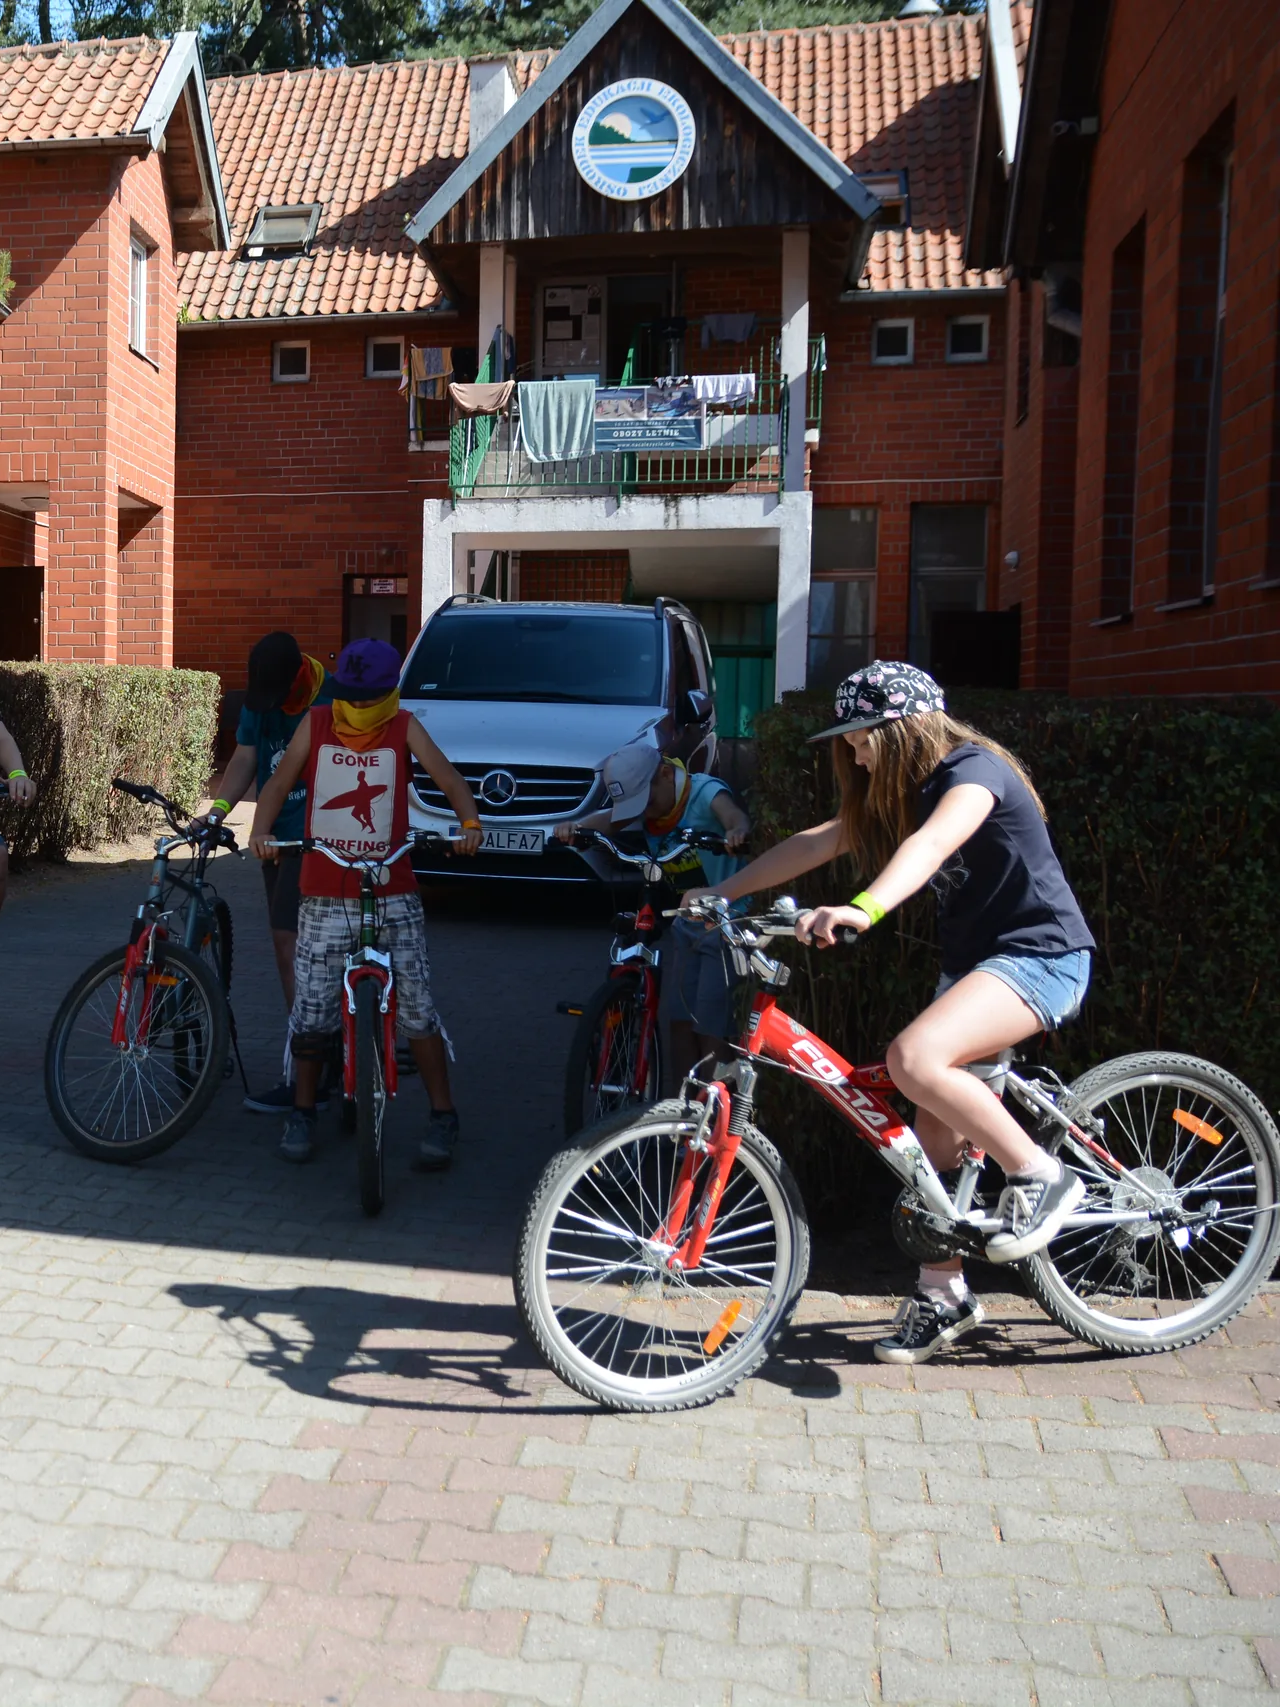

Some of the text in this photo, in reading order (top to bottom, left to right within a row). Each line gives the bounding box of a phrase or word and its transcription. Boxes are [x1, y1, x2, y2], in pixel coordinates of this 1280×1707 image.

[645, 429, 680, 437] LETNIE
[332, 752, 380, 768] GONE
[485, 831, 540, 850] ALFA7
[791, 1039, 889, 1127] FOLTA
